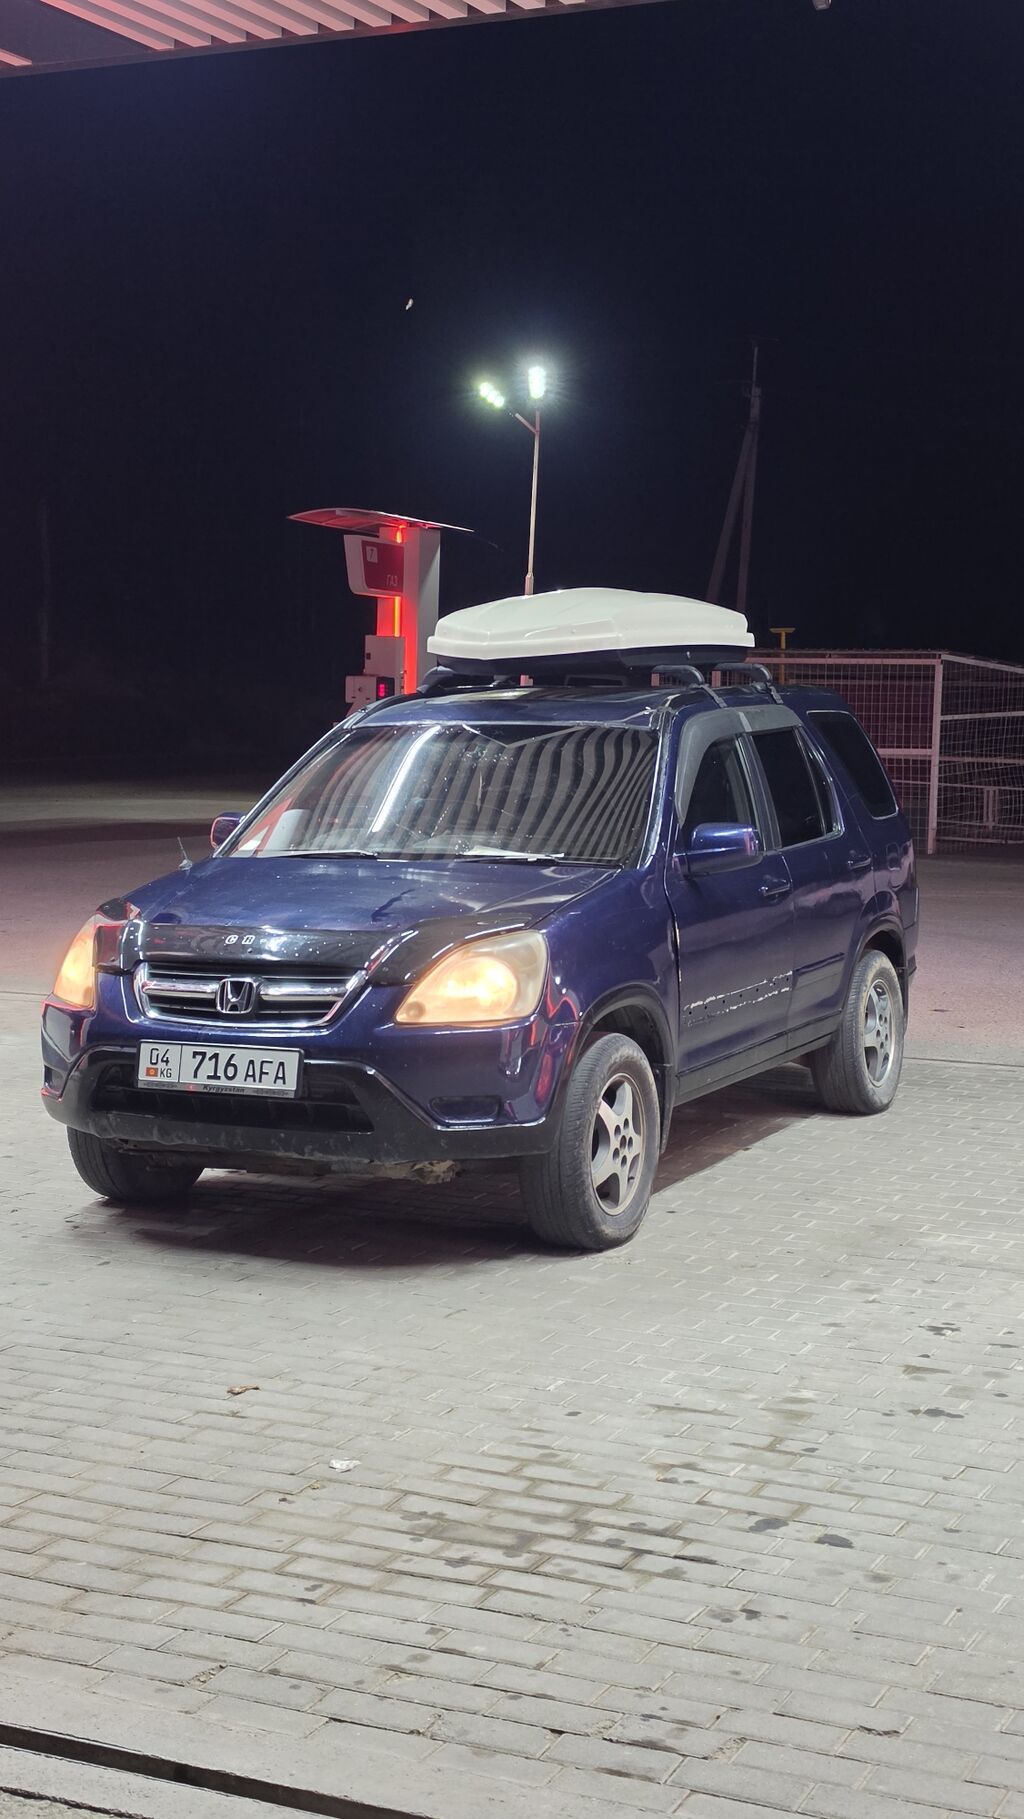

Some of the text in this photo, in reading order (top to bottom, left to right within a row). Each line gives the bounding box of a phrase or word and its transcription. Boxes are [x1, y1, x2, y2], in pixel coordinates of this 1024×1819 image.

[386, 574, 399, 587] ГАЗ
[149, 1047, 170, 1067] 04
[159, 1068, 173, 1079] KG
[192, 1050, 287, 1086] 716 AFA
[202, 1083, 246, 1094] Kyrgyzstan
